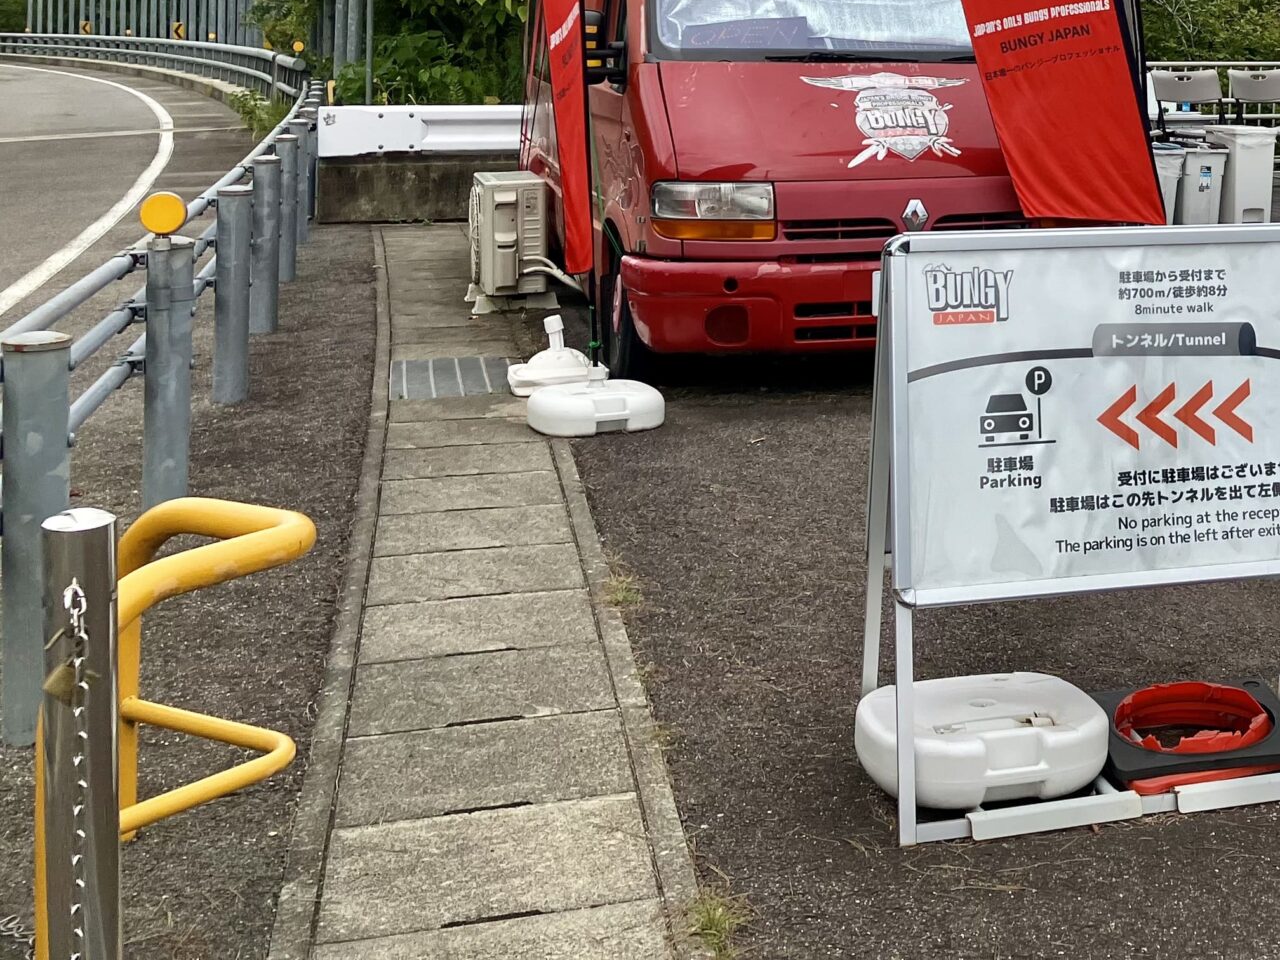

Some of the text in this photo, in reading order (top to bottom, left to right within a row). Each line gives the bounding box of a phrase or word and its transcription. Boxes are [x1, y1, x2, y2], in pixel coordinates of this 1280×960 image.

[1003, 13, 1023, 28] ONLY
[1000, 23, 1091, 54] BUNGY JAPAN
[866, 106, 938, 135] BUNGY
[1118, 269, 1227, 284] 駐車場から受付まで
[926, 265, 1014, 322] BUNGY
[1118, 285, 1228, 301] 約700m/徒歩約8分
[1187, 302, 1214, 314] walk
[935, 312, 993, 323] JAPAN
[1111, 332, 1226, 348] トンネル/Tunnel
[987, 455, 1034, 473] 駐車場
[979, 473, 1042, 489] Parking
[1118, 516, 1138, 530] No
[1141, 514, 1193, 532] parking
[1196, 510, 1211, 524] at
[1215, 509, 1239, 522] the
[1056, 540, 1081, 554] The
[1083, 535, 1134, 554] parking
[1136, 536, 1148, 548] is
[1150, 535, 1166, 546] on
[1169, 531, 1192, 545] the
[1194, 528, 1219, 542] left
[1221, 526, 1256, 540] after
